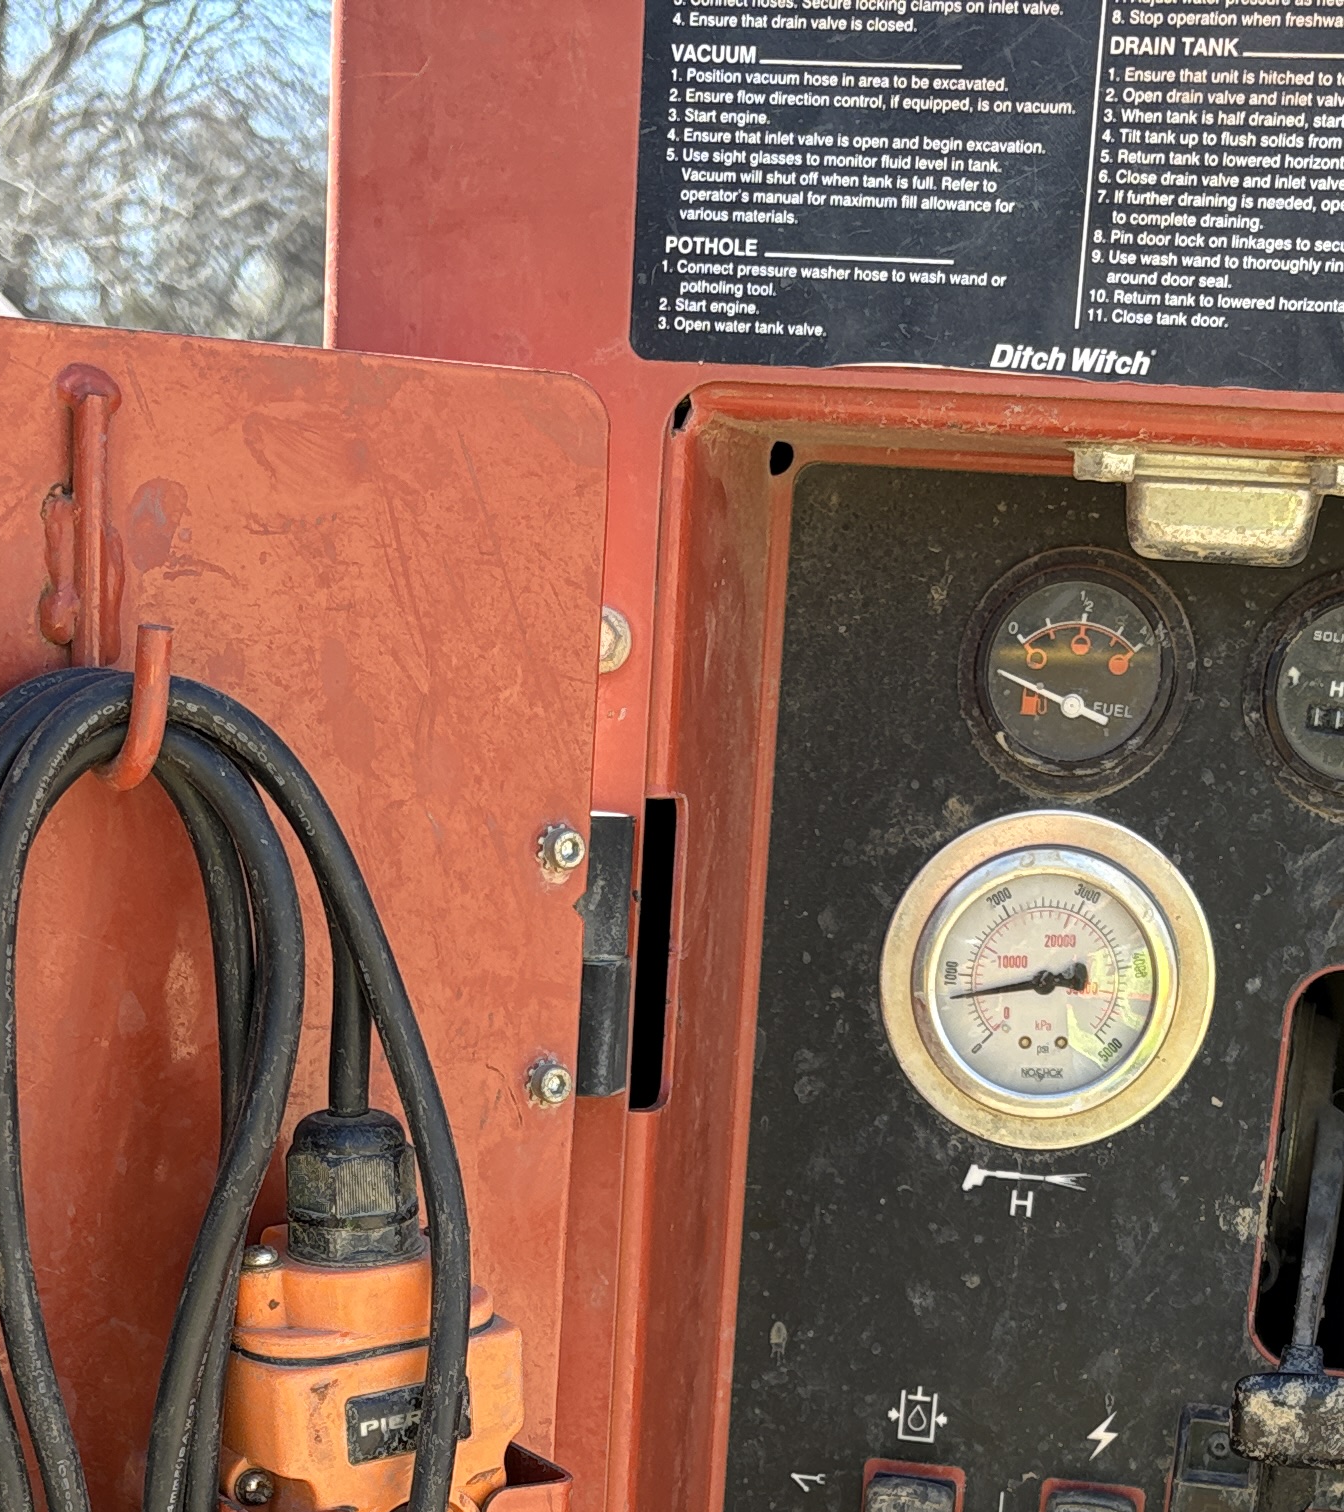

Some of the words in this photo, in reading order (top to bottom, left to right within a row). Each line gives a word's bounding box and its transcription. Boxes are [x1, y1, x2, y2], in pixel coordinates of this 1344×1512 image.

[672, 12, 685, 26] 4.
[689, 11, 738, 28] Ensure
[741, 13, 768, 29] that
[771, 14, 807, 29] drain
[810, 15, 848, 31] valve
[850, 16, 863, 31] is
[866, 17, 918, 32] closed.
[1111, 9, 1125, 25] 8.
[1129, 9, 1164, 28] Stop
[1167, 10, 1238, 29] operation
[1241, 11, 1282, 27] when
[670, 44, 757, 64] VACUUM
[1109, 35, 1176, 56] DRAIN
[1181, 37, 1239, 57] TANK
[671, 67, 683, 82] 1.
[686, 67, 742, 84] Position
[745, 72, 800, 86] vacuum
[803, 71, 839, 87] hose
[841, 72, 855, 87] in
[858, 75, 890, 89] area
[893, 75, 908, 89] to
[911, 75, 930, 90] be
[932, 77, 1009, 92] excavated.
[667, 107, 681, 122] 3.
[684, 107, 717, 123] Start
[719, 109, 771, 128] engine.
[665, 235, 758, 257] POTHOLE
[1106, 271, 1158, 286] around
[1160, 271, 1196, 287] door
[1198, 274, 1232, 289] seal.
[658, 297, 671, 311] 2.
[675, 297, 707, 313] Start
[709, 300, 760, 317] engine.
[657, 316, 670, 330] 3.
[673, 316, 711, 334] Open
[714, 319, 752, 333] water
[754, 320, 784, 335] tank
[787, 322, 827, 337] valve.
[1087, 308, 1108, 322] 11.
[1111, 308, 1154, 325] Close
[1156, 311, 1188, 326] tank
[1190, 312, 1229, 328] door.
[990, 343, 1067, 371] Ditch
[1008, 622, 1018, 634] 0
[1094, 702, 1133, 718] FUEL
[986, 887, 1012, 909] 2000
[1074, 884, 1102, 904] 3000
[1045, 935, 1076, 947] 20000
[998, 955, 1028, 968] 10000
[944, 961, 958, 986] 1000
[1035, 1021, 1051, 1031] kPa
[1037, 1044, 1049, 1055] psi
[1098, 1038, 1123, 1062] 5000
[1010, 1190, 1033, 1217] H
[360, 1410, 423, 1437] PIER
